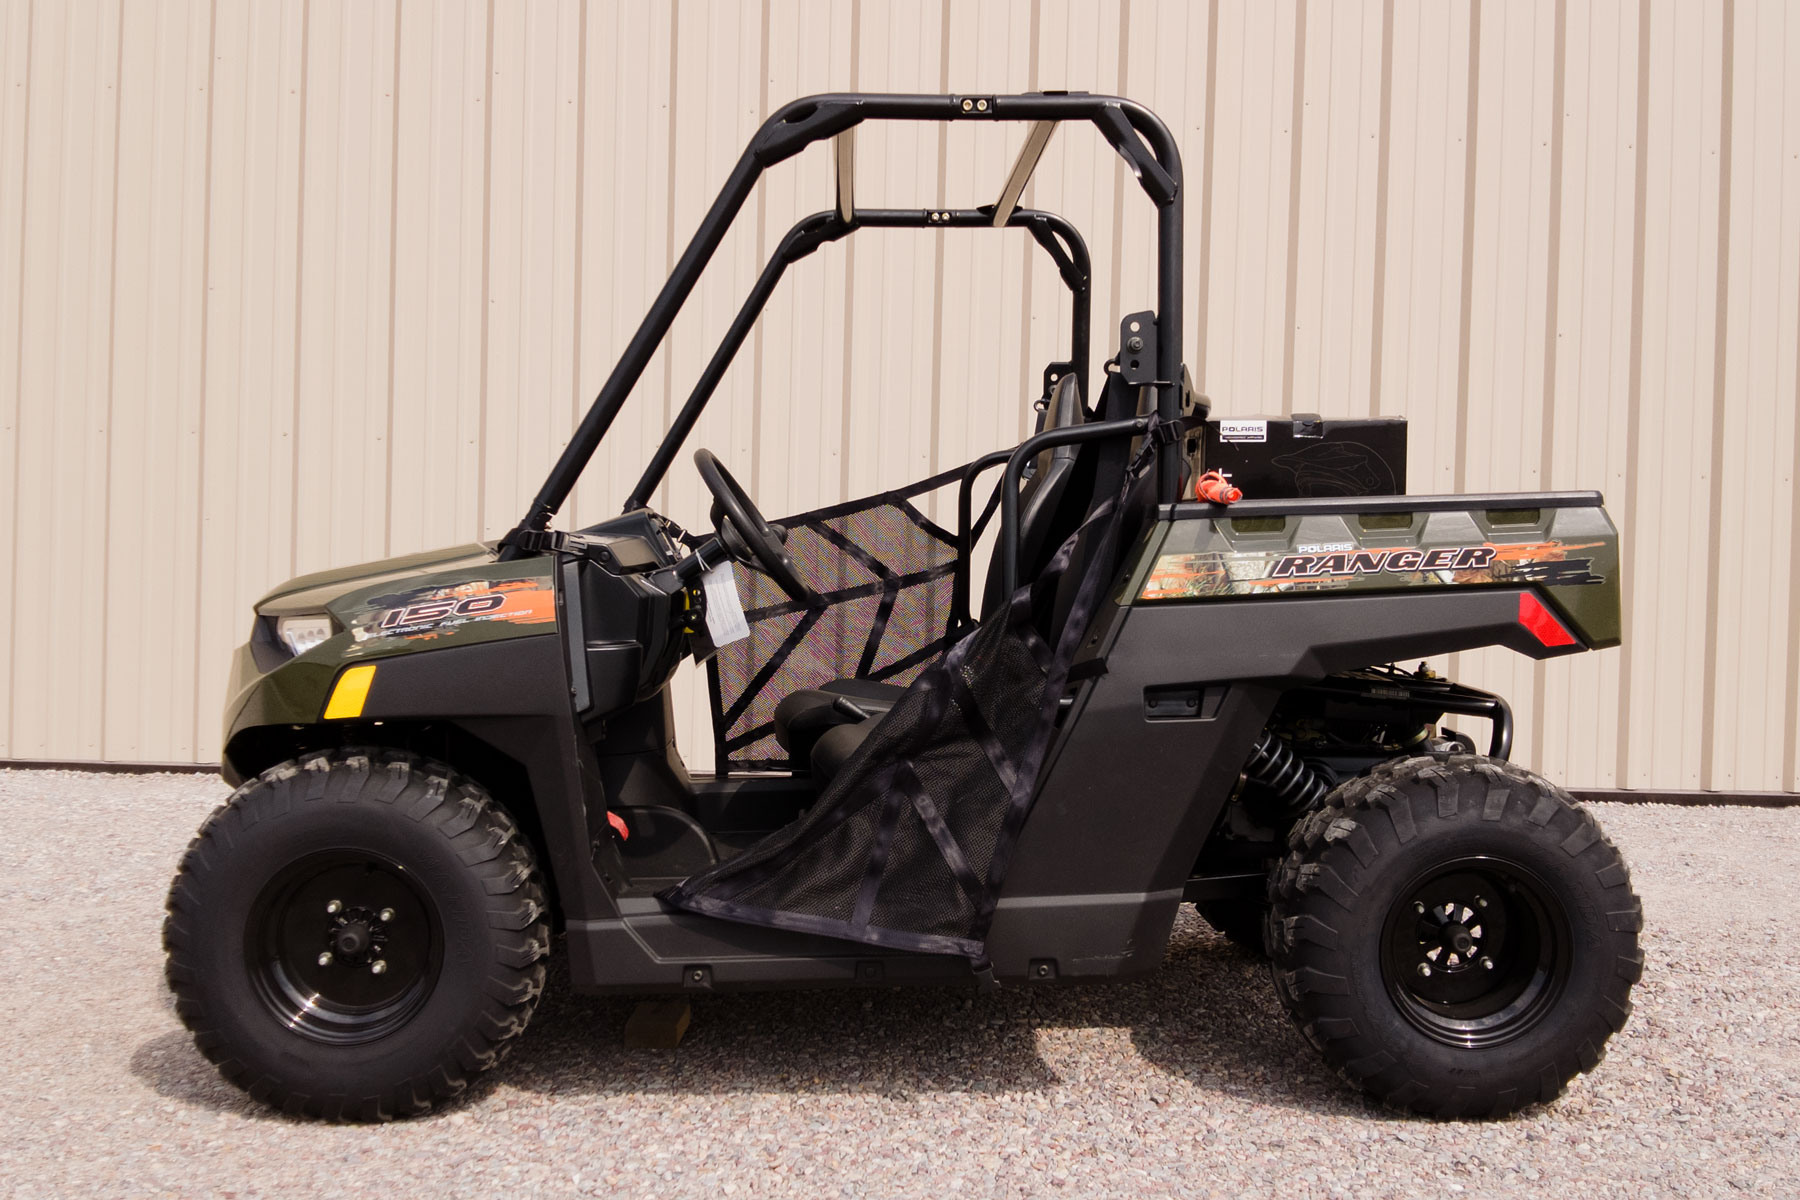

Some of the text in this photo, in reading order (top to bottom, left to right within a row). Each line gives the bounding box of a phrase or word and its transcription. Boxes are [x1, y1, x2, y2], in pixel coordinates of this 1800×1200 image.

[1272, 547, 1497, 578] RANGER
[1299, 544, 1353, 553] POLARIS
[380, 594, 507, 629] 150
